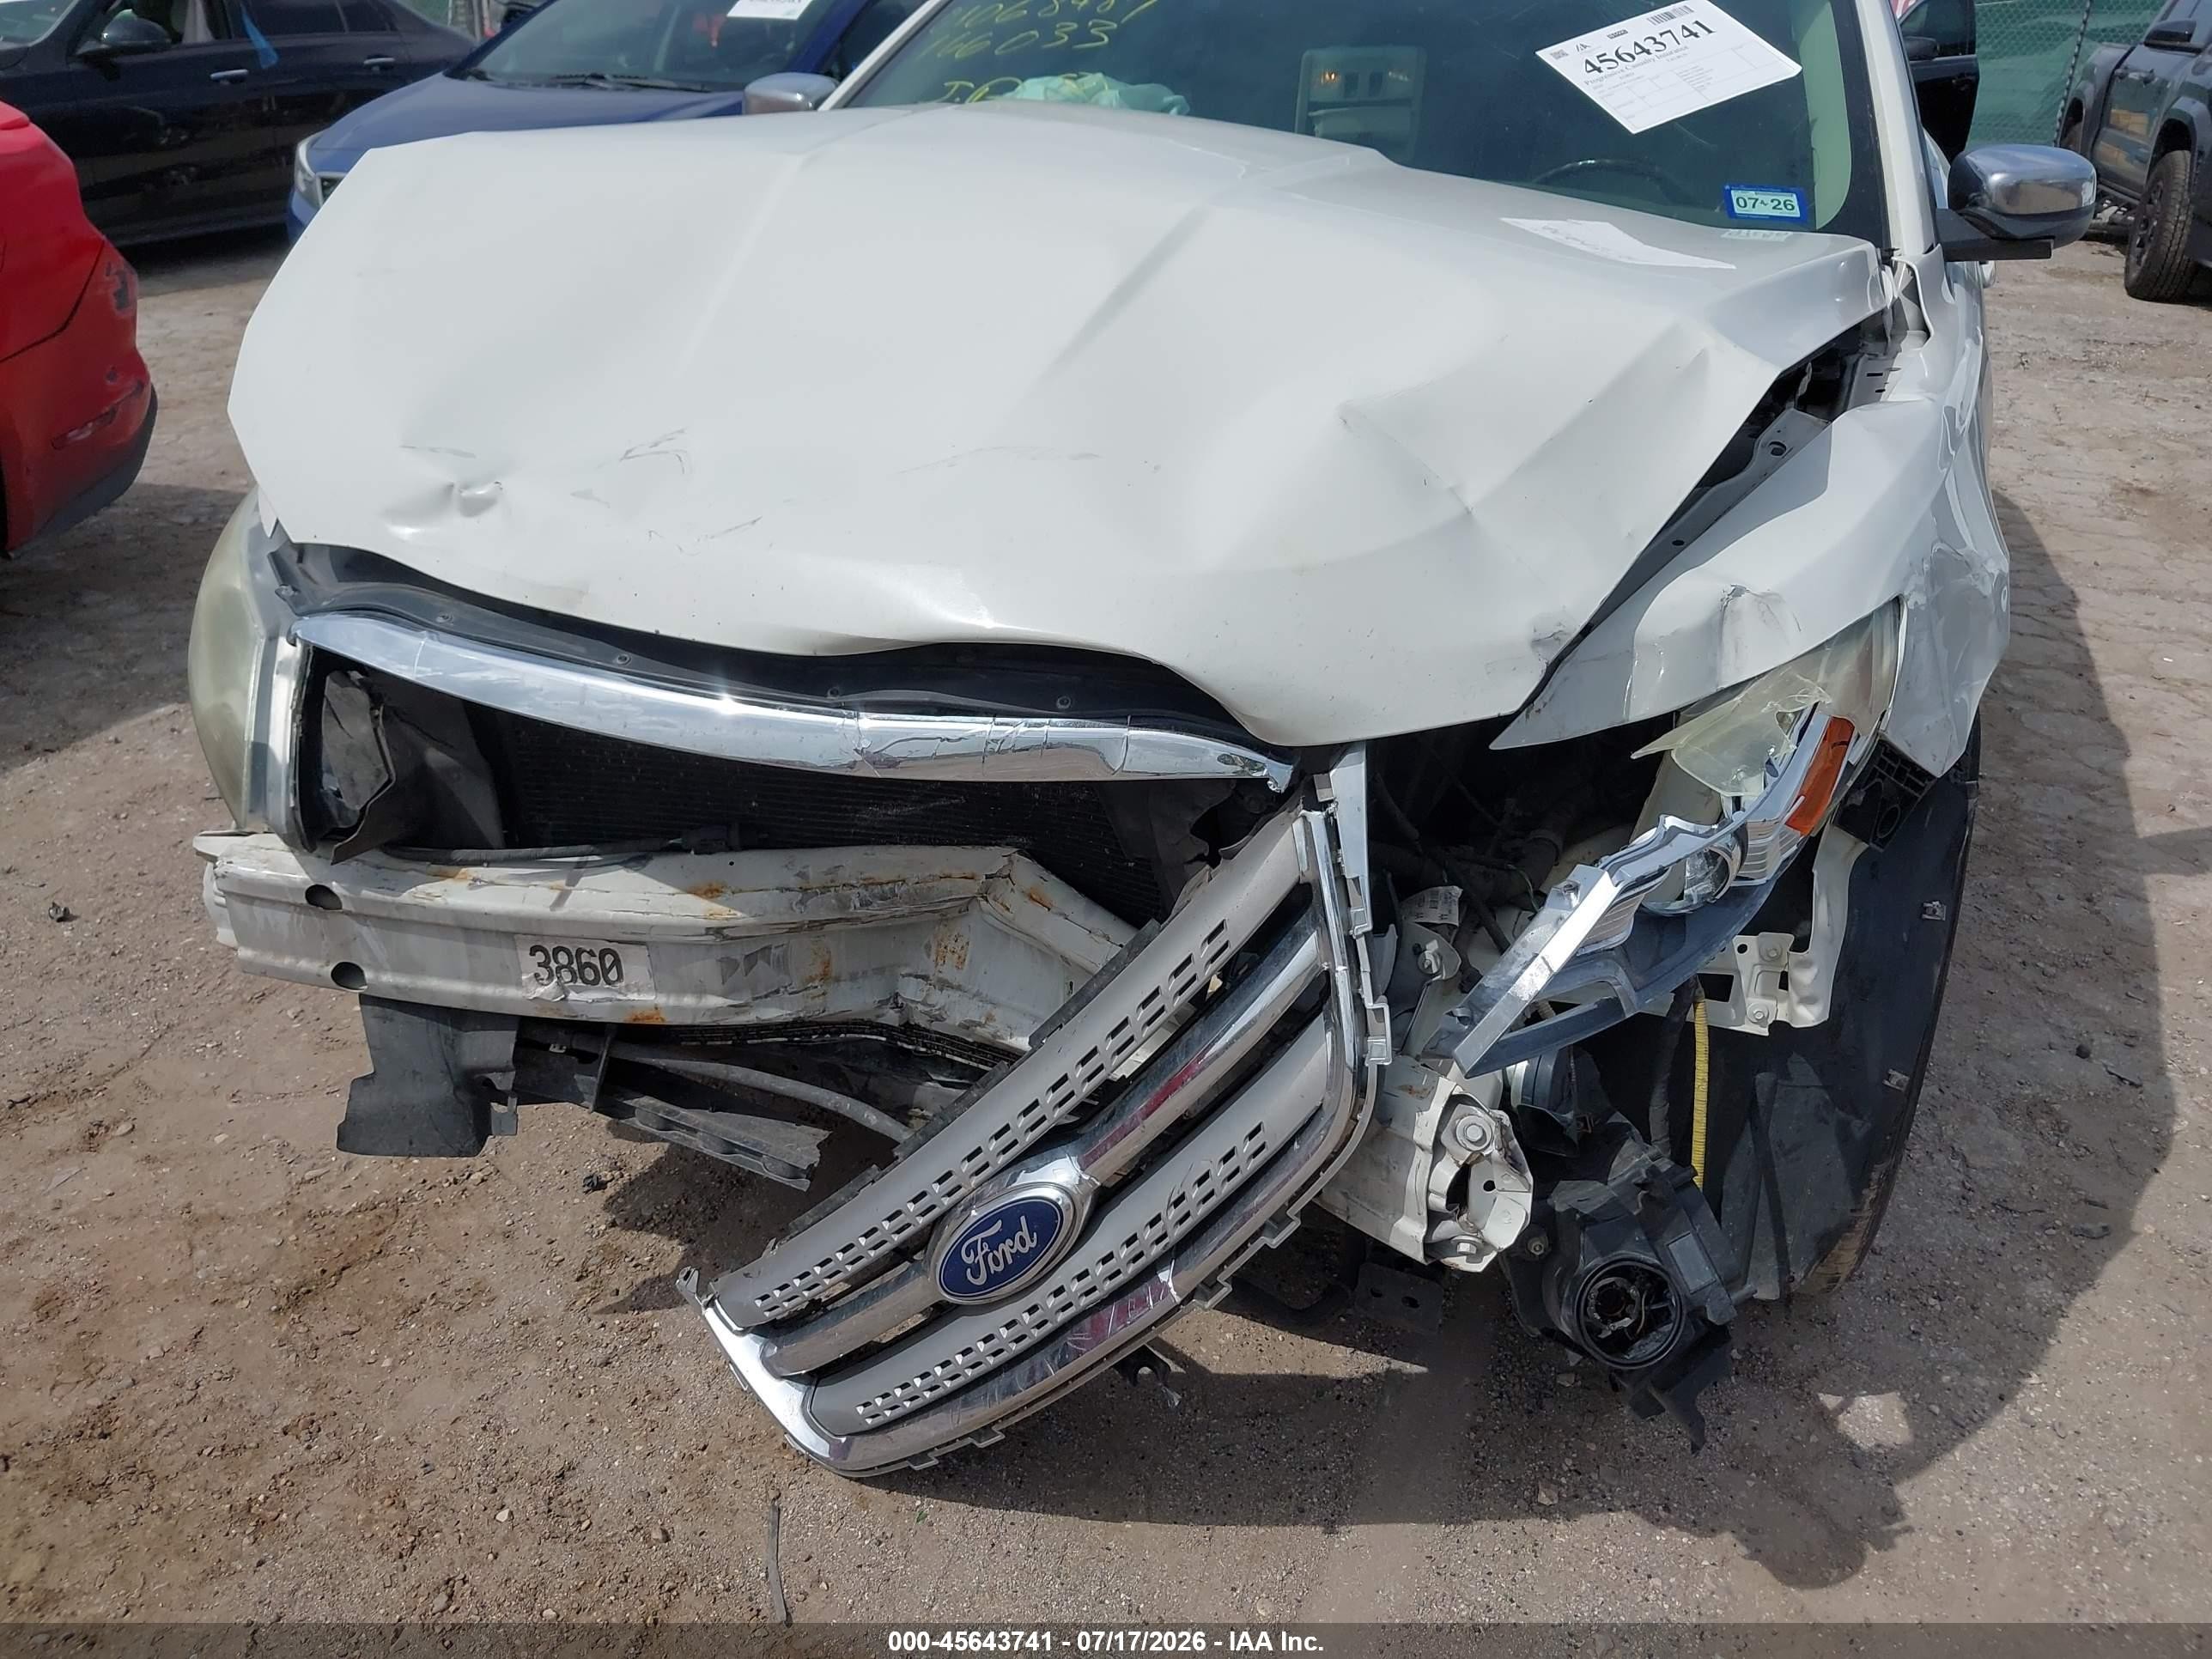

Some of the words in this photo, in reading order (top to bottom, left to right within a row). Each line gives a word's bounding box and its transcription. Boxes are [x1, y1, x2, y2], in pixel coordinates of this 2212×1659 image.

[1584, 20, 1717, 74] 45643741
[1735, 197, 1759, 209] 07
[1770, 198, 1796, 211] 26
[529, 945, 624, 987] 3860
[960, 1215, 1037, 1285] Ford
